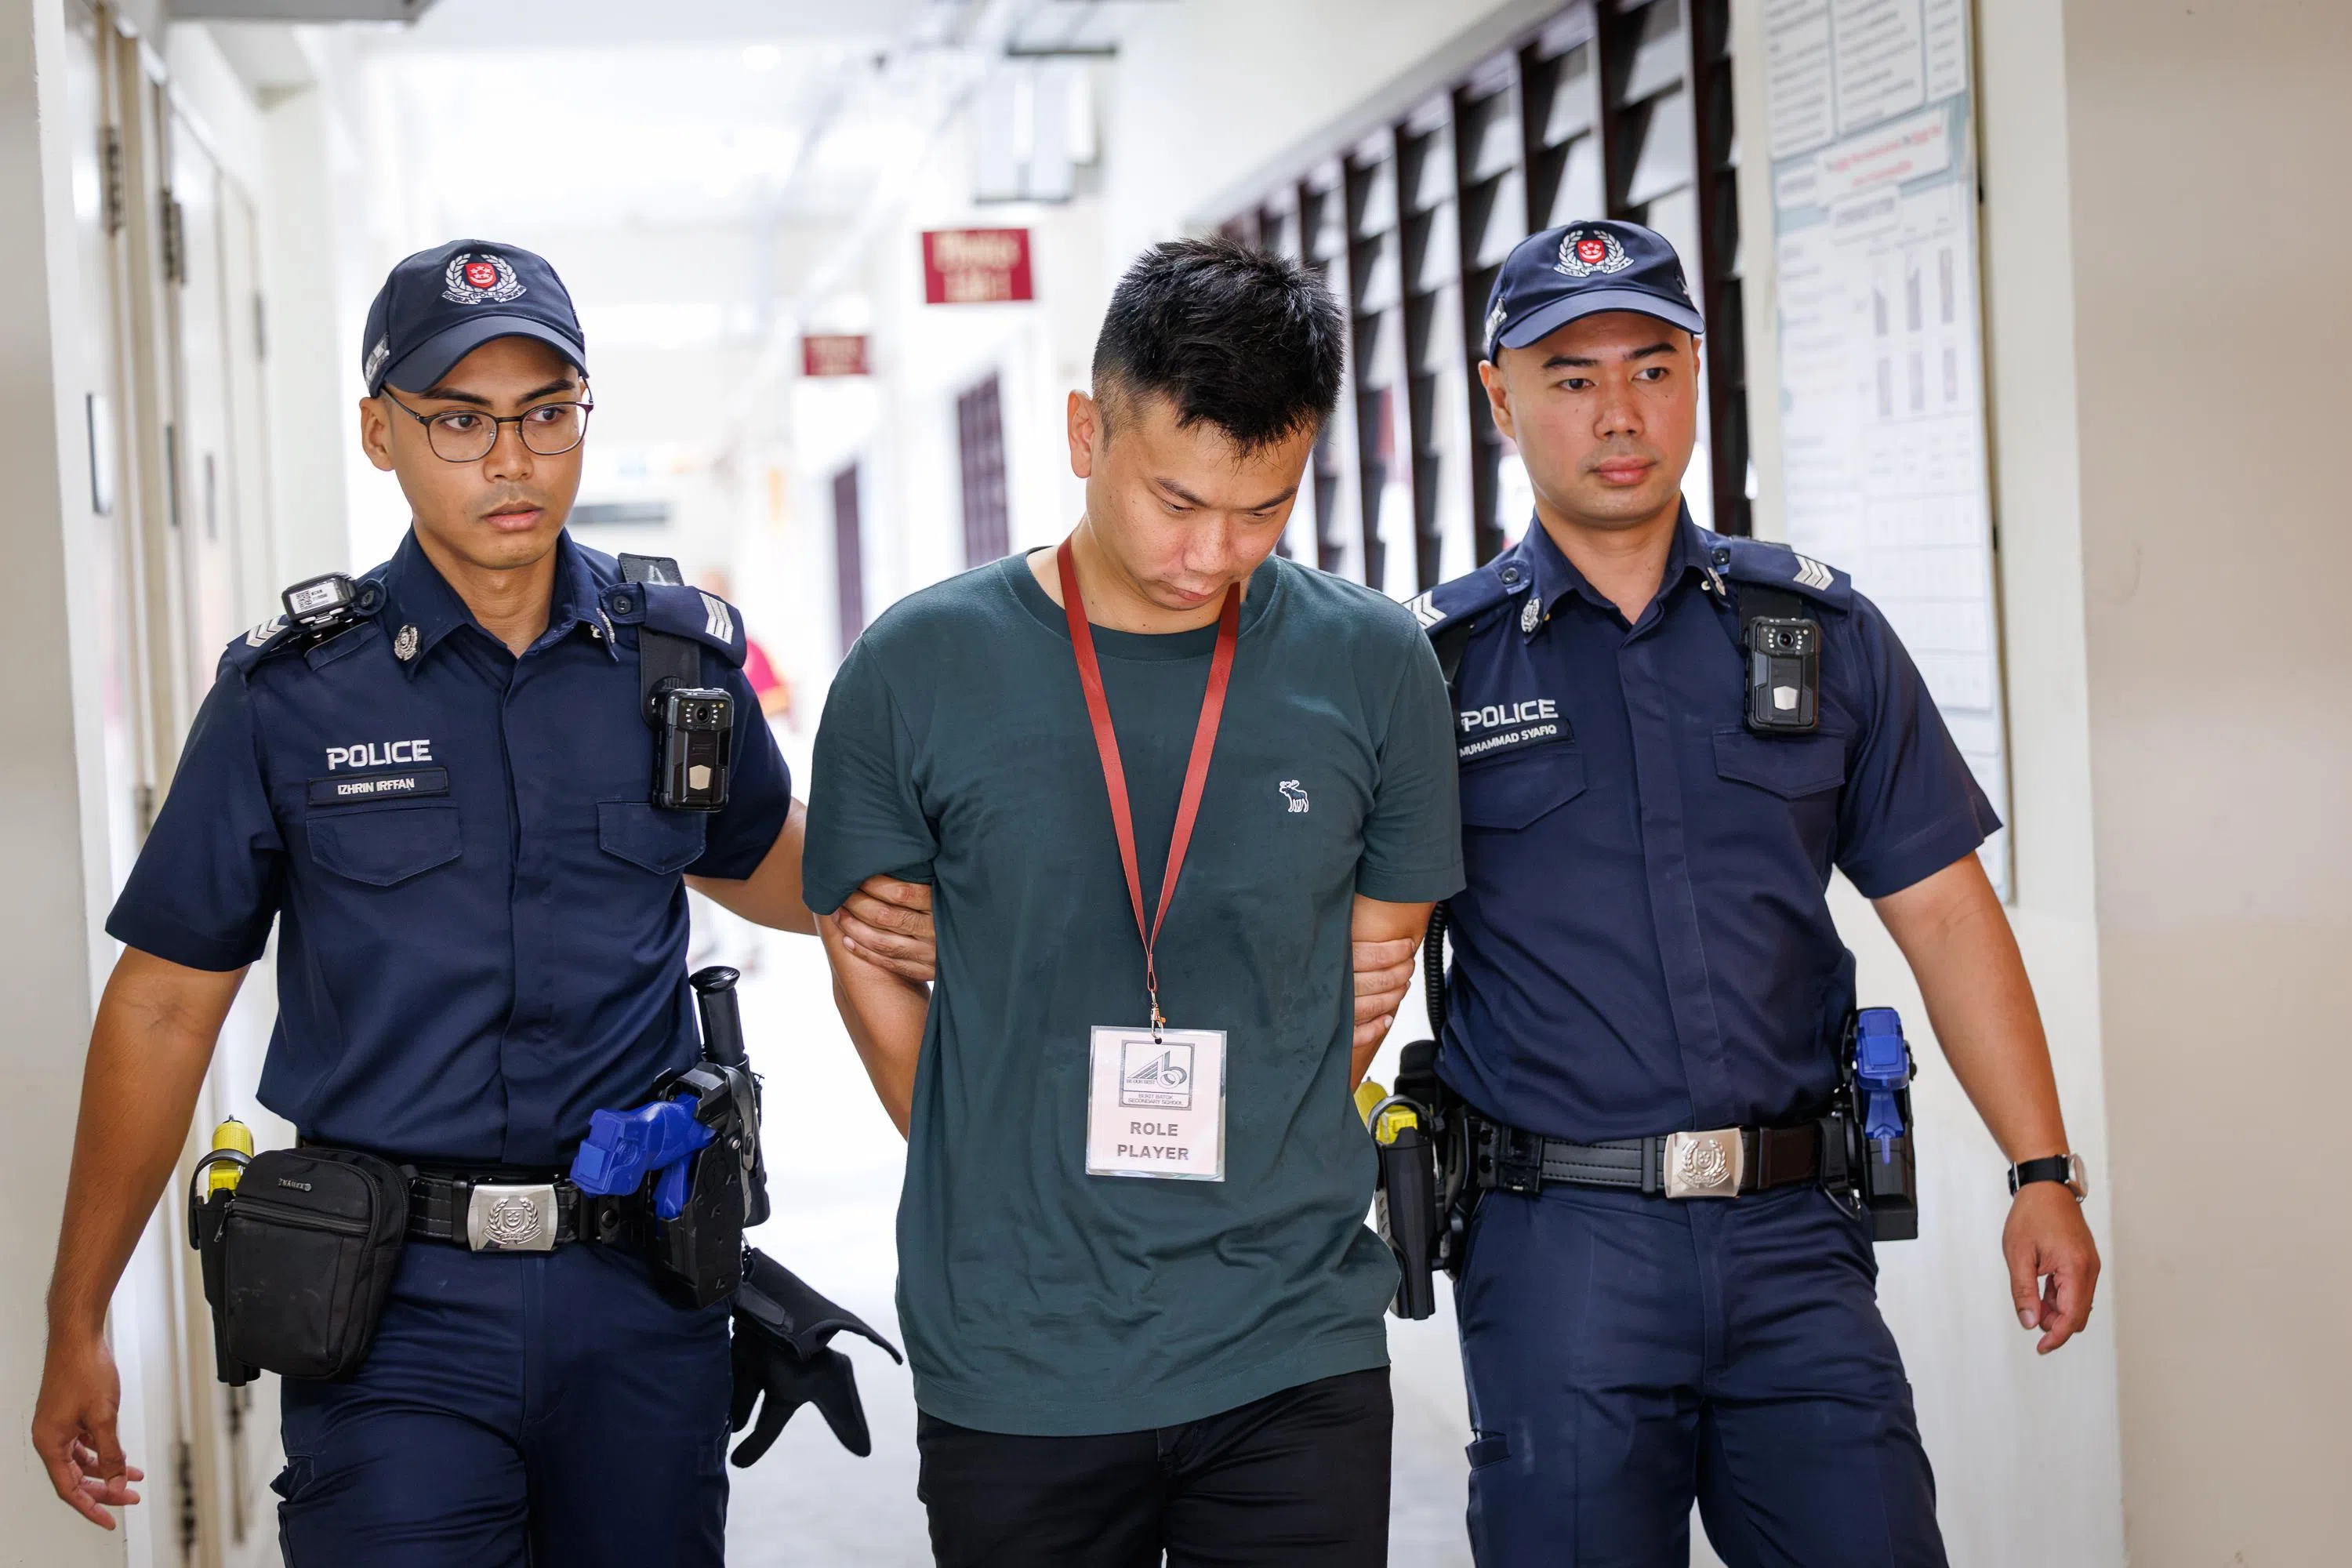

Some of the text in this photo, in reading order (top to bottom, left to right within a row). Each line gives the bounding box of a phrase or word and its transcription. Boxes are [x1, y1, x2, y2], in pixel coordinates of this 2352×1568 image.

[1461, 699, 1559, 732] POLICE
[1459, 724, 1557, 757] MUHAMMAD SYAFIQ
[326, 739, 433, 771] POLICE
[337, 778, 415, 795] IZHRIN IRFFAN
[1130, 1121, 1178, 1137] ROLE
[1116, 1144, 1189, 1160] PLAYER
